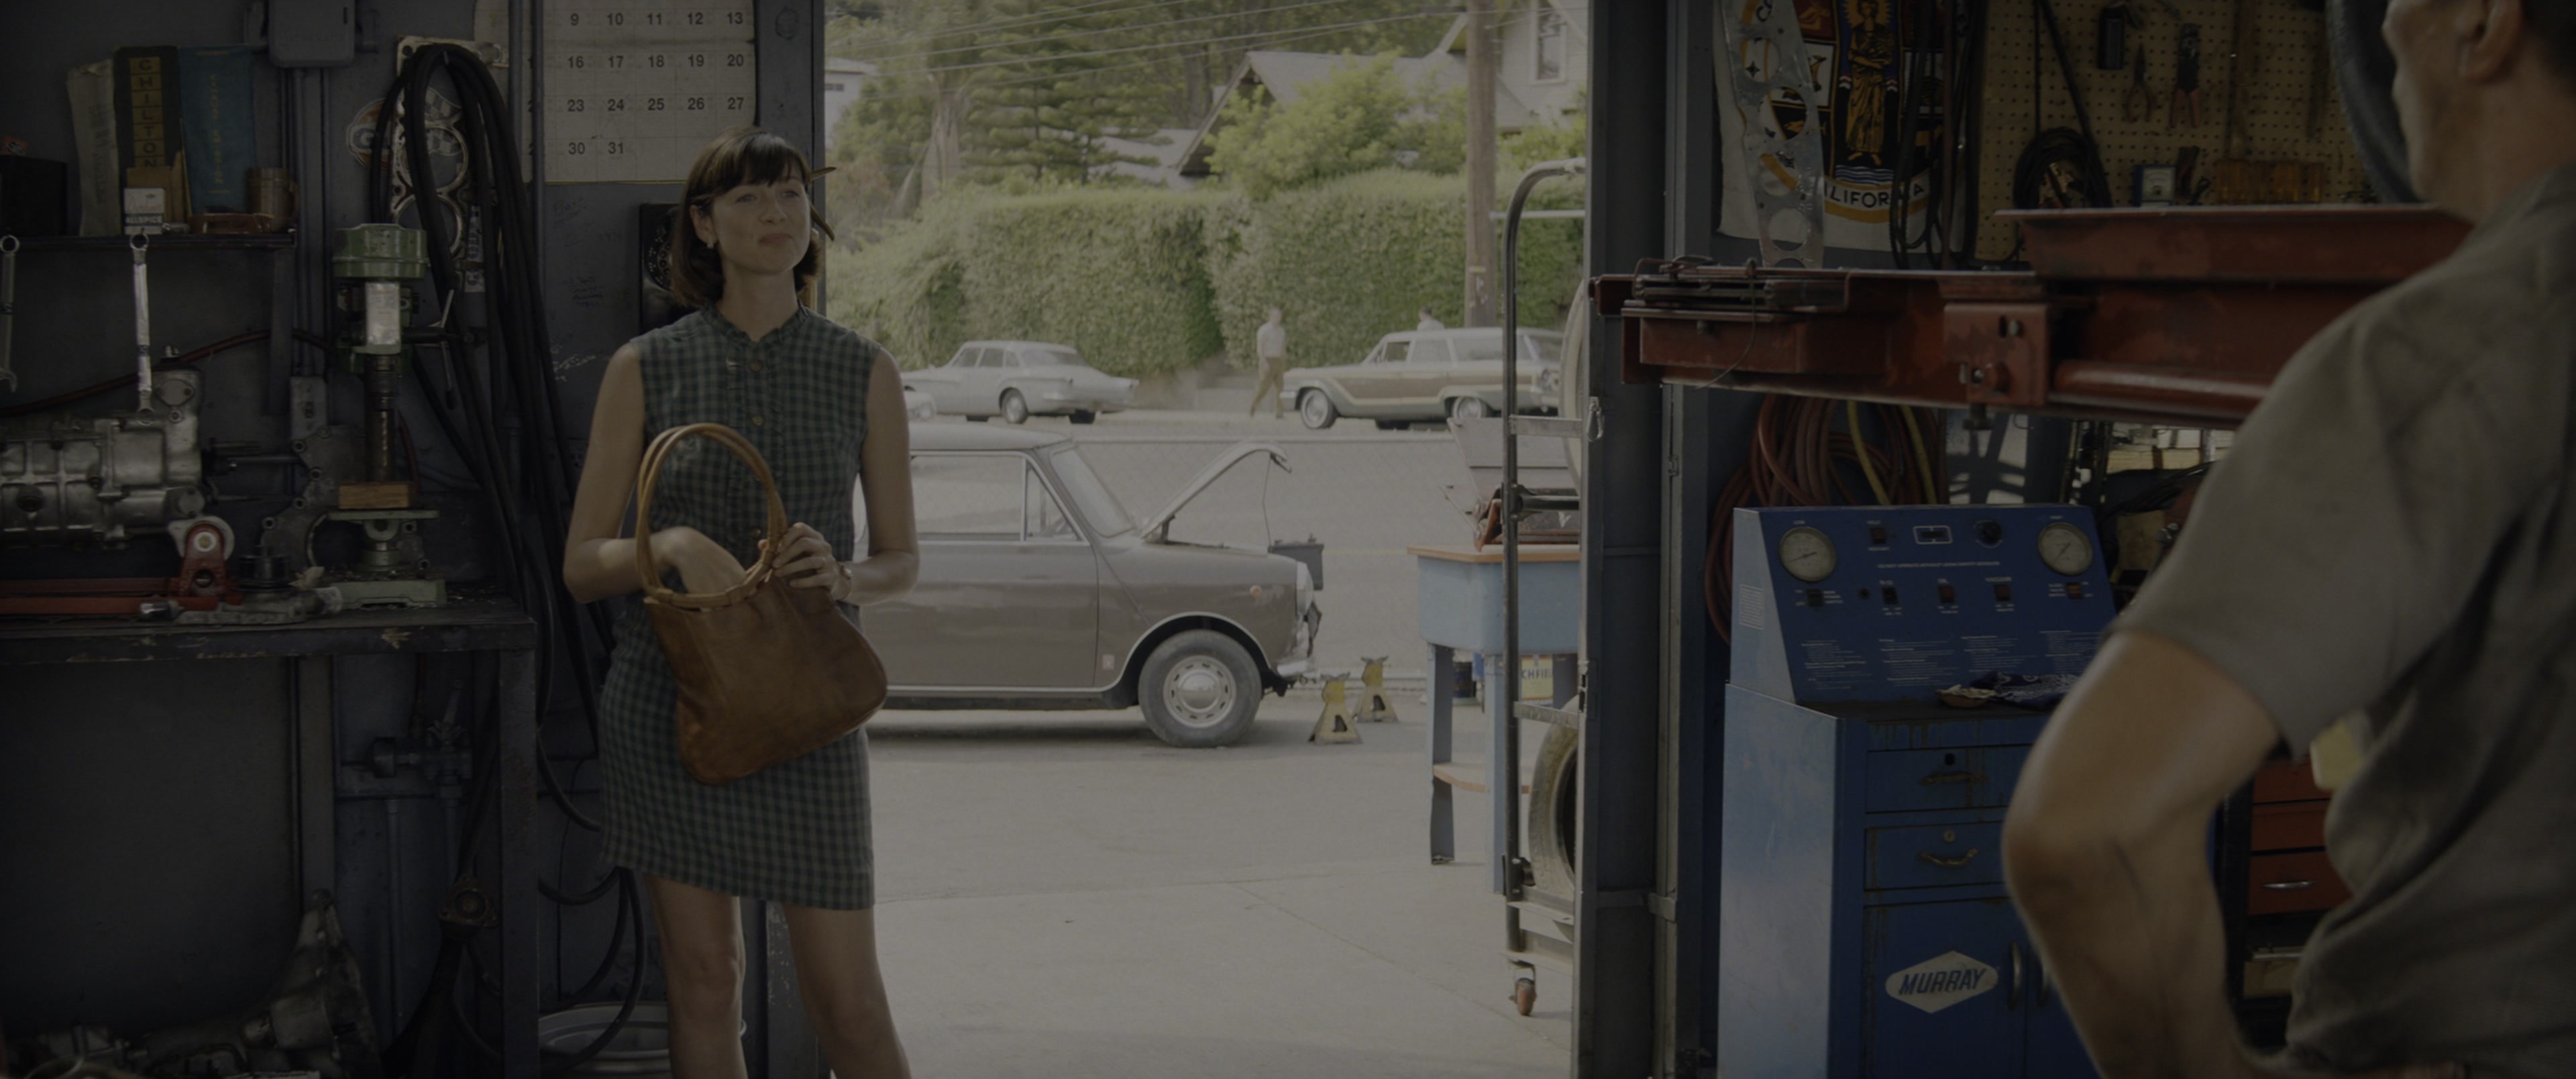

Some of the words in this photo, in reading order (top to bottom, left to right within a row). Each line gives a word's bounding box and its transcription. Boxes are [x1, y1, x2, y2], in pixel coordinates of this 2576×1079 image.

[570, 13, 580, 26] 9
[607, 12, 624, 25] 10
[647, 12, 662, 25] 11
[688, 11, 704, 25] 12
[727, 11, 744, 25] 13
[568, 56, 584, 69] 16
[608, 55, 625, 68] 17
[648, 54, 665, 68] 18
[688, 54, 704, 68] 19
[727, 54, 744, 67] 20
[568, 99, 584, 112] 23
[608, 99, 625, 112] 24
[647, 97, 665, 111] 25
[688, 97, 705, 110] 26
[727, 97, 744, 110] 27
[139, 59, 156, 168] CHILTON
[568, 142, 586, 155] 30
[608, 142, 624, 155] 31
[1898, 968, 1986, 995] MURRAY
